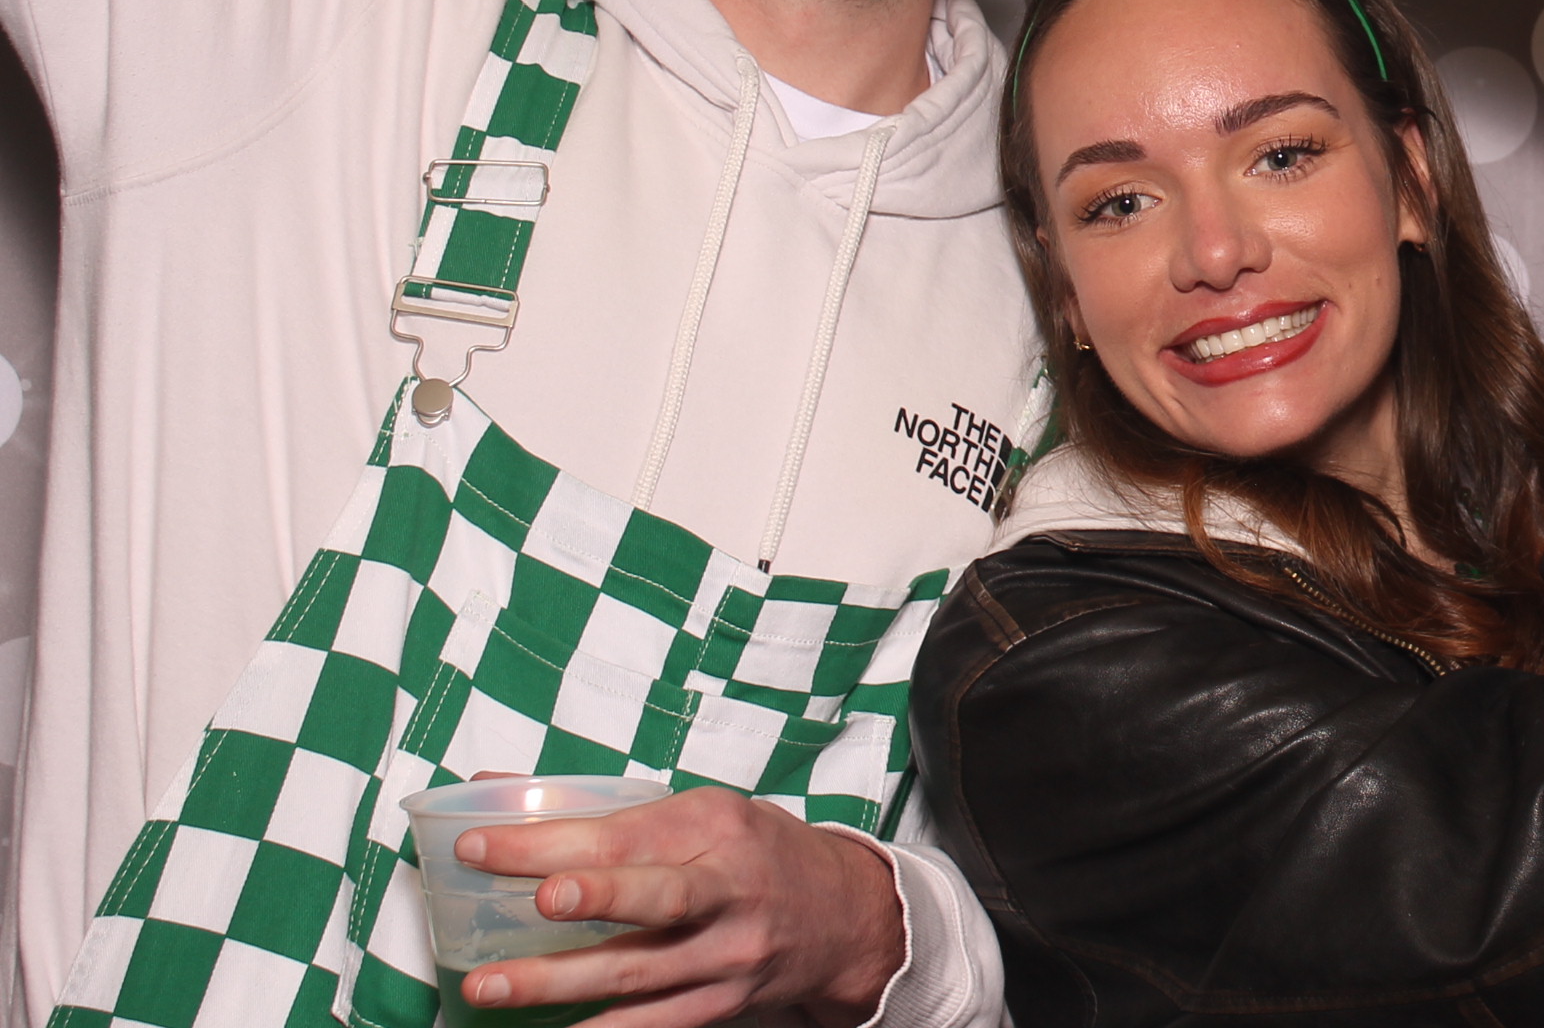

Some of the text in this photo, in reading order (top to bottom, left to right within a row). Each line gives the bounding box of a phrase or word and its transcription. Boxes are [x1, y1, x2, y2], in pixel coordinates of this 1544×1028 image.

[894, 406, 995, 479] NORTH
[951, 402, 1001, 455] THE
[915, 447, 986, 506] FACE
